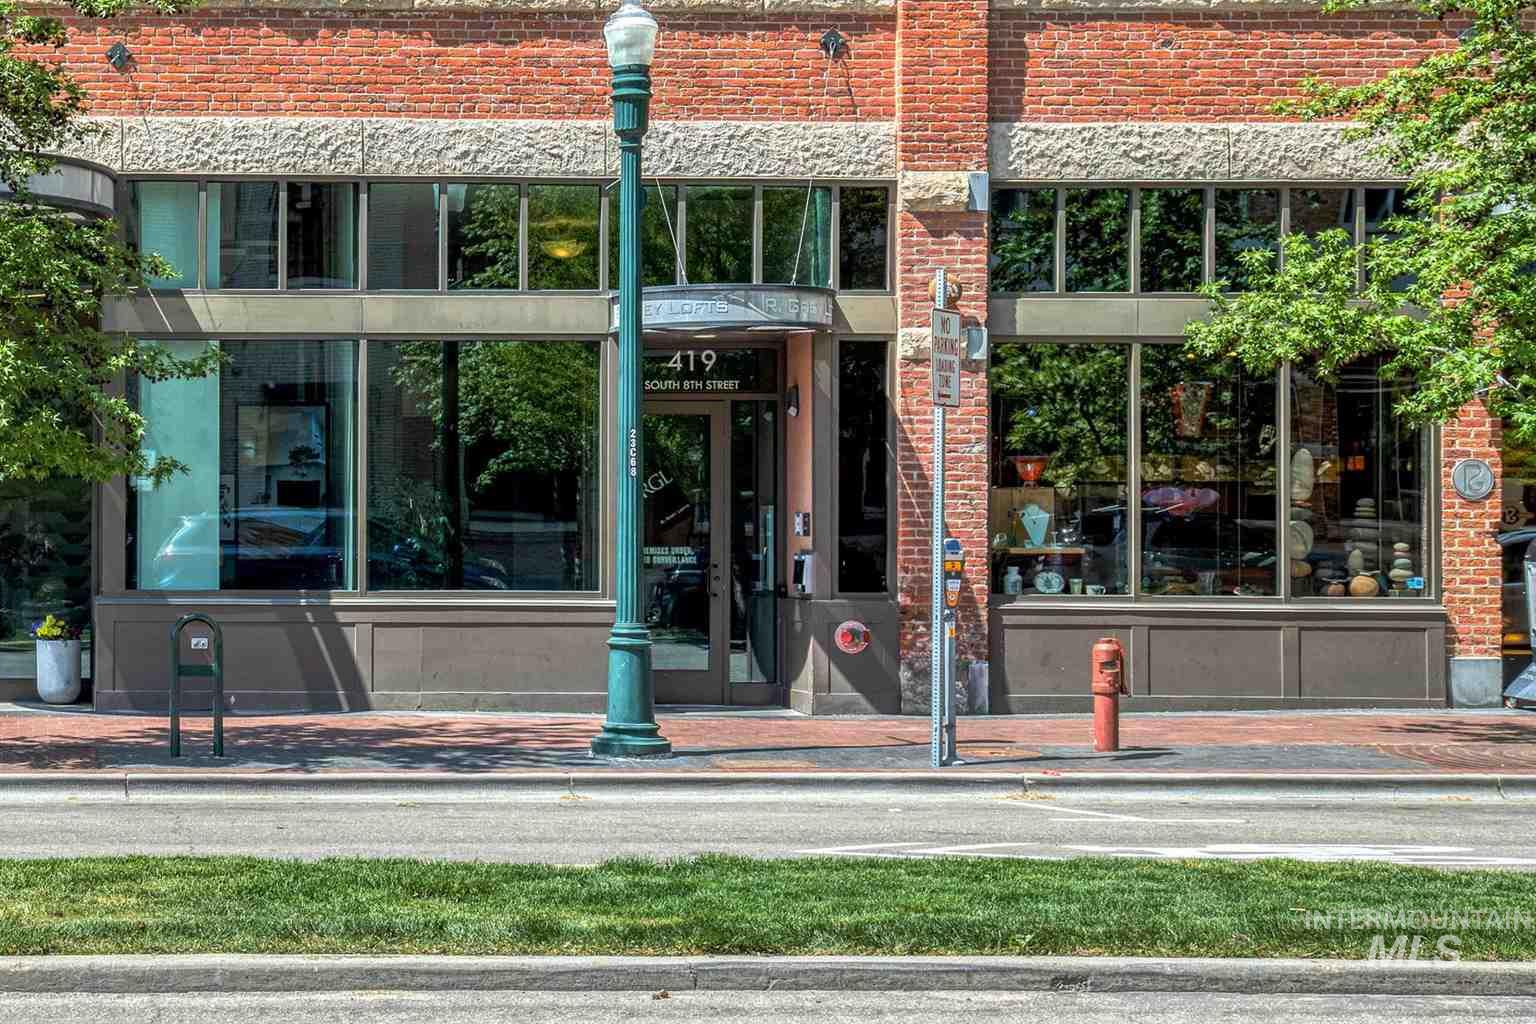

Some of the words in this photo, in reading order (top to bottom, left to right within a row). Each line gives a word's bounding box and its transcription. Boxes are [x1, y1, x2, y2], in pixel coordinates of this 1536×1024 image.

[666, 301, 729, 315] LOFTS
[667, 350, 717, 373] 419
[644, 379, 681, 391] SOUTH
[683, 379, 703, 391] 8TH
[705, 379, 740, 391] STREET
